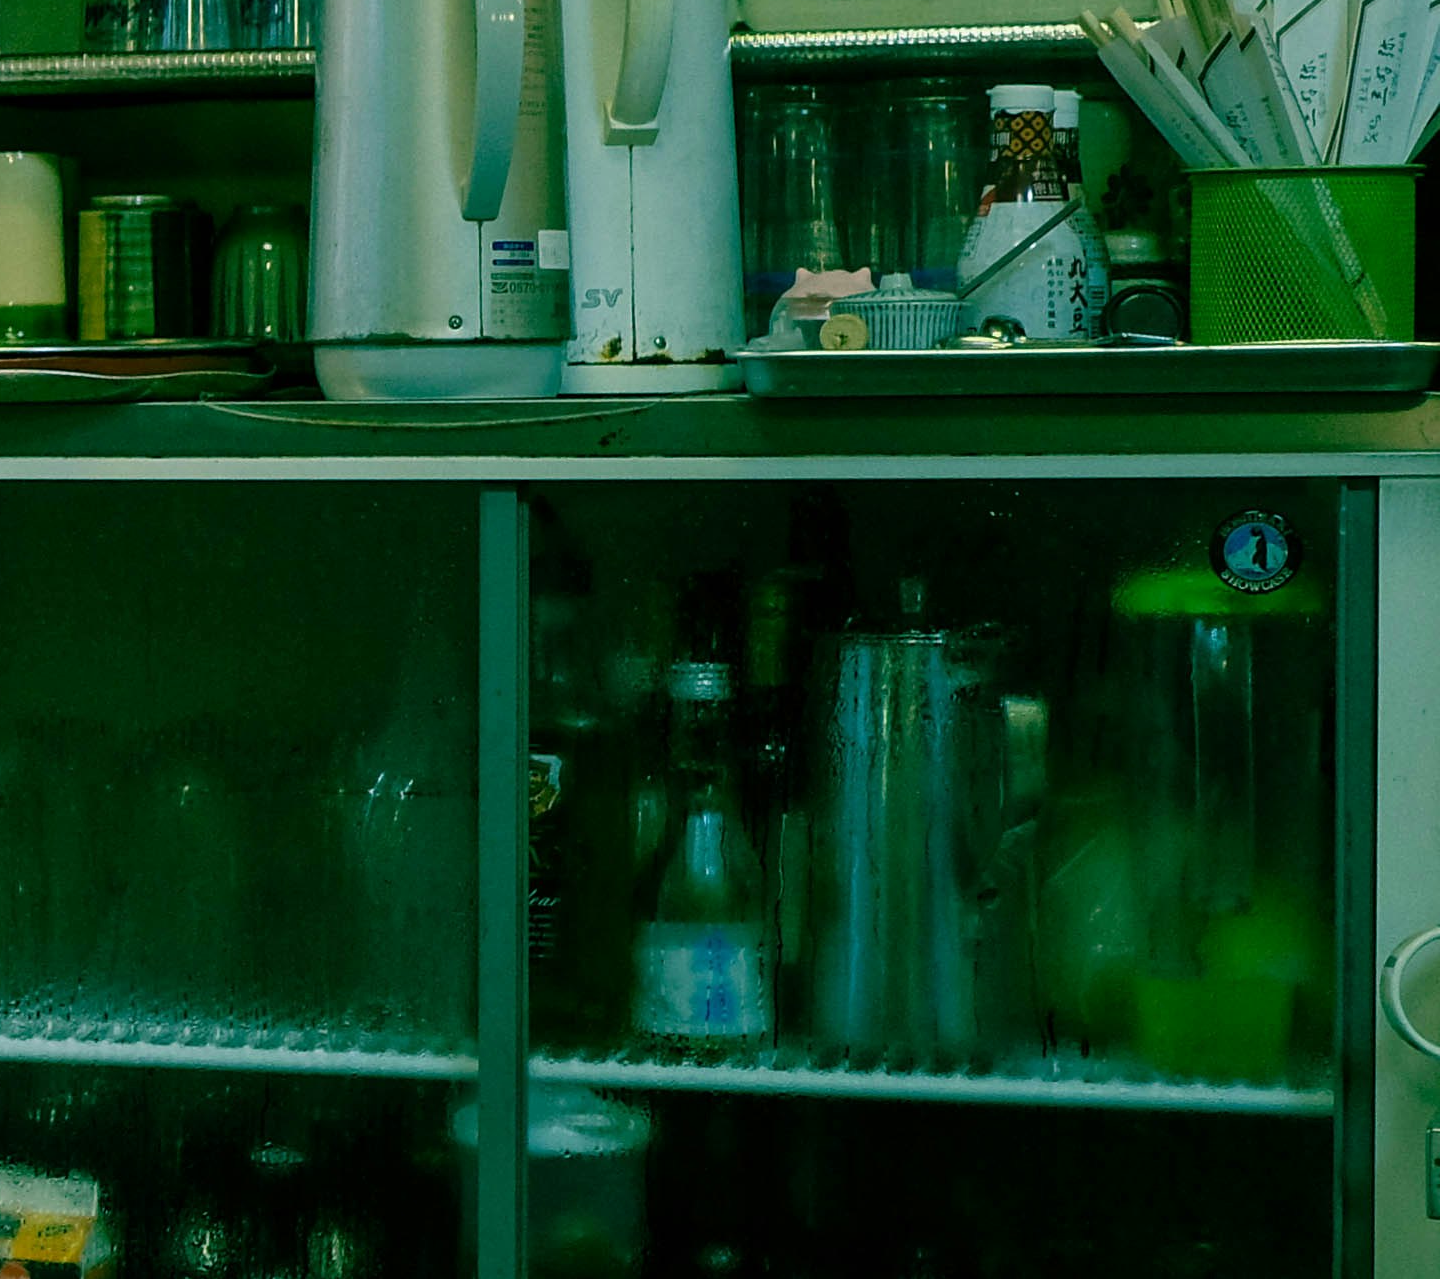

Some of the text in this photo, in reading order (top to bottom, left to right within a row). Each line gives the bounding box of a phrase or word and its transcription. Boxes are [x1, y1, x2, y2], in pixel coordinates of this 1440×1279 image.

[582, 288, 623, 309] SV
[1068, 255, 1089, 334] 丸大豆
